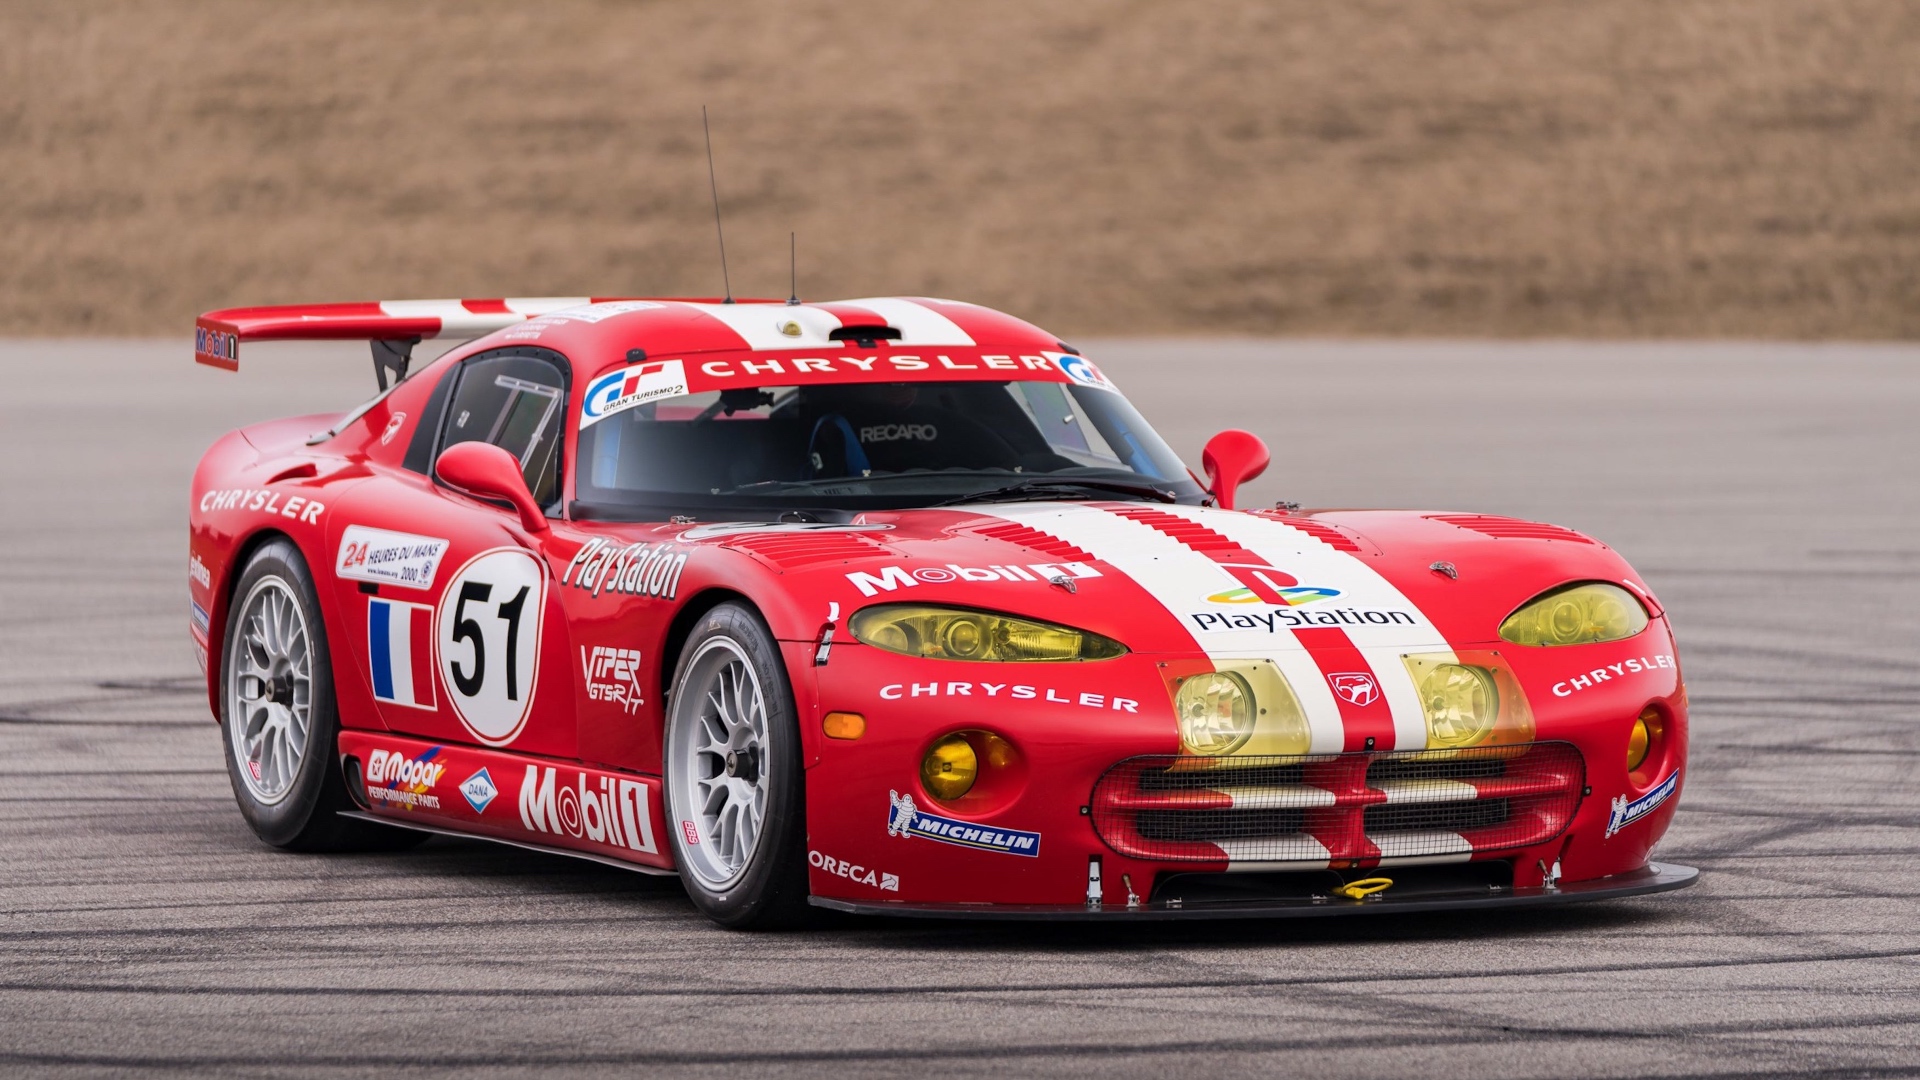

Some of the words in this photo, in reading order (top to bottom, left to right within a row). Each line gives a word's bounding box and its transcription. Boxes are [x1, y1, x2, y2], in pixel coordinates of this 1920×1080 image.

[196, 326, 227, 358] Mobil
[701, 355, 1053, 377] CHRYSLER
[603, 397, 628, 411] GRAN
[631, 386, 673, 401] TURISMO
[673, 384, 683, 395] 2
[860, 424, 937, 443] RECARO
[200, 489, 325, 525] CHRYSLER
[343, 541, 370, 568] 24
[368, 547, 399, 565] HEURES
[398, 545, 414, 560] DU
[412, 543, 440, 559] MANS
[562, 537, 688, 599] PlayStation
[401, 566, 418, 581] 2000
[845, 564, 1038, 597] Mobil
[1191, 607, 1416, 633] PlayStation
[450, 580, 531, 701] 51
[580, 645, 641, 697] VIPER
[1552, 654, 1676, 697] CHRYSLER
[879, 681, 1139, 713] CHRYSLER
[385, 751, 443, 789] Mopar
[367, 785, 418, 806] PERFORMANCE
[418, 794, 441, 809] PARTS
[468, 783, 488, 797] DANA
[519, 764, 626, 847] Mobil
[1625, 775, 1677, 820] MICHELIN
[684, 821, 699, 844] BBS
[917, 818, 1035, 850] MICHELIN
[808, 850, 878, 887] ORECA
